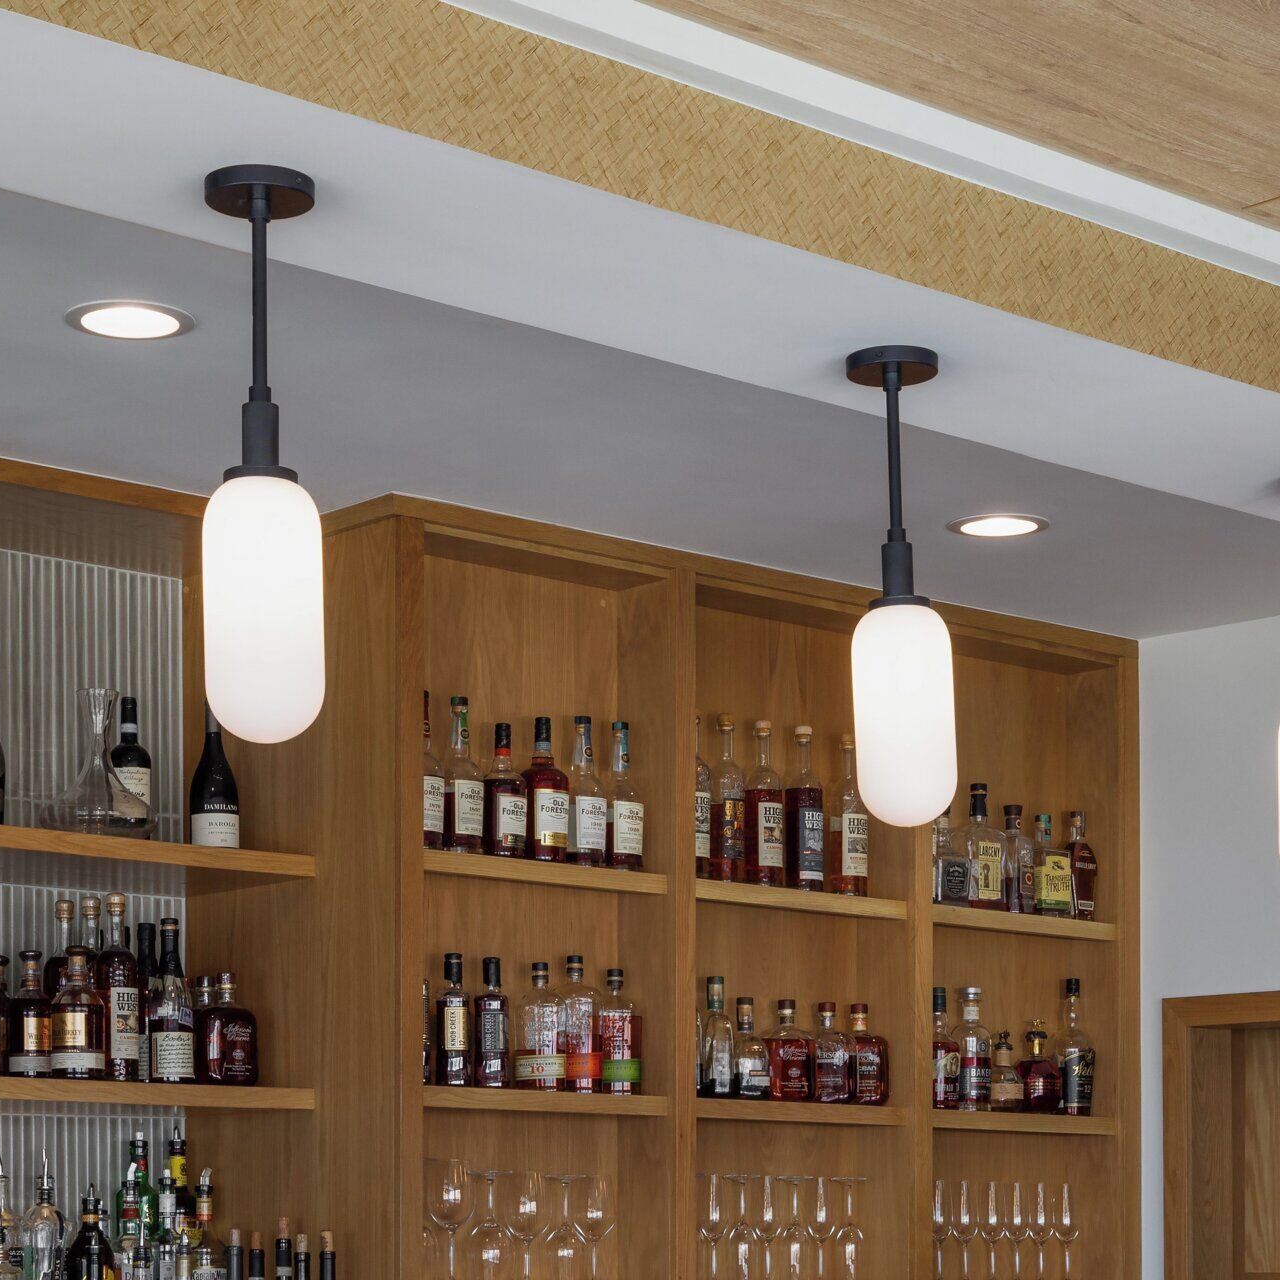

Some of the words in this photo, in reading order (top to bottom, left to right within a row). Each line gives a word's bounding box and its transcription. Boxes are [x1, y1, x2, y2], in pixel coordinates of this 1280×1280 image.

[204, 803, 238, 811] DAMILANO
[513, 802, 523, 810] OLD
[540, 804, 568, 815] FORESTE
[764, 807, 782, 816] HIG
[764, 816, 783, 825] WES
[805, 821, 824, 830] WES
[848, 827, 867, 836] WES
[979, 844, 1000, 858] LARCENY
[1049, 881, 1070, 893] TRUTH
[116, 1002, 138, 1012] WES
[449, 1010, 457, 1029] CREEK
[485, 1014, 493, 1032] CREEK
[485, 1033, 493, 1050] KNOB
[970, 1067, 991, 1077] BAKER
